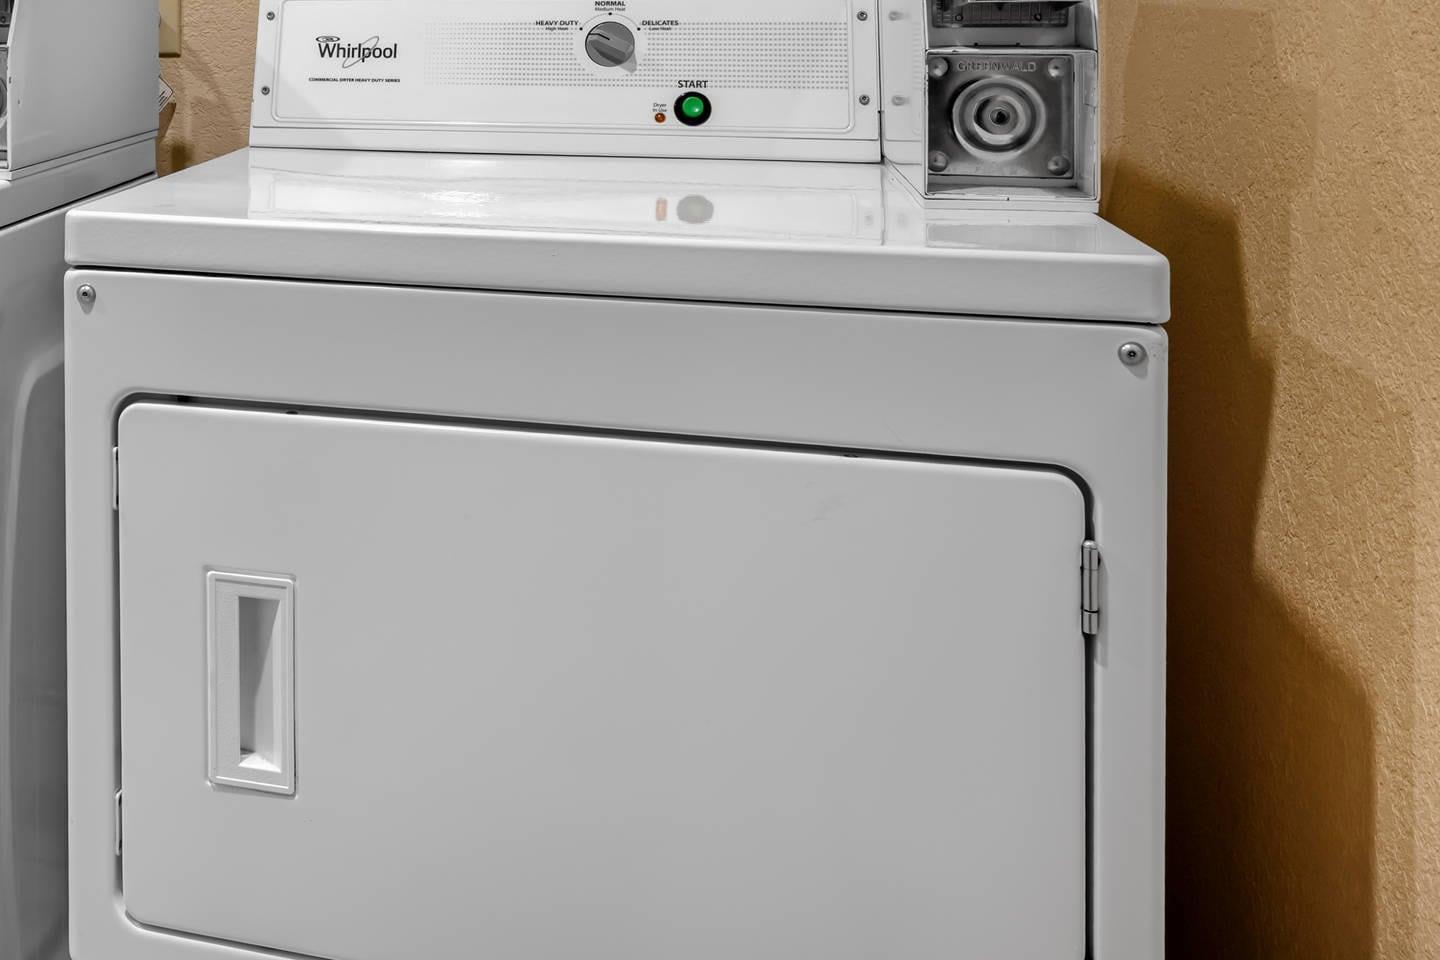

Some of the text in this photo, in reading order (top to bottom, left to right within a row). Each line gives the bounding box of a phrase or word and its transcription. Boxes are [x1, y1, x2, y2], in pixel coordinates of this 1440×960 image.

[318, 43, 397, 62] Whirlpool
[957, 61, 1037, 72] GREENWALD
[677, 80, 708, 88] START
